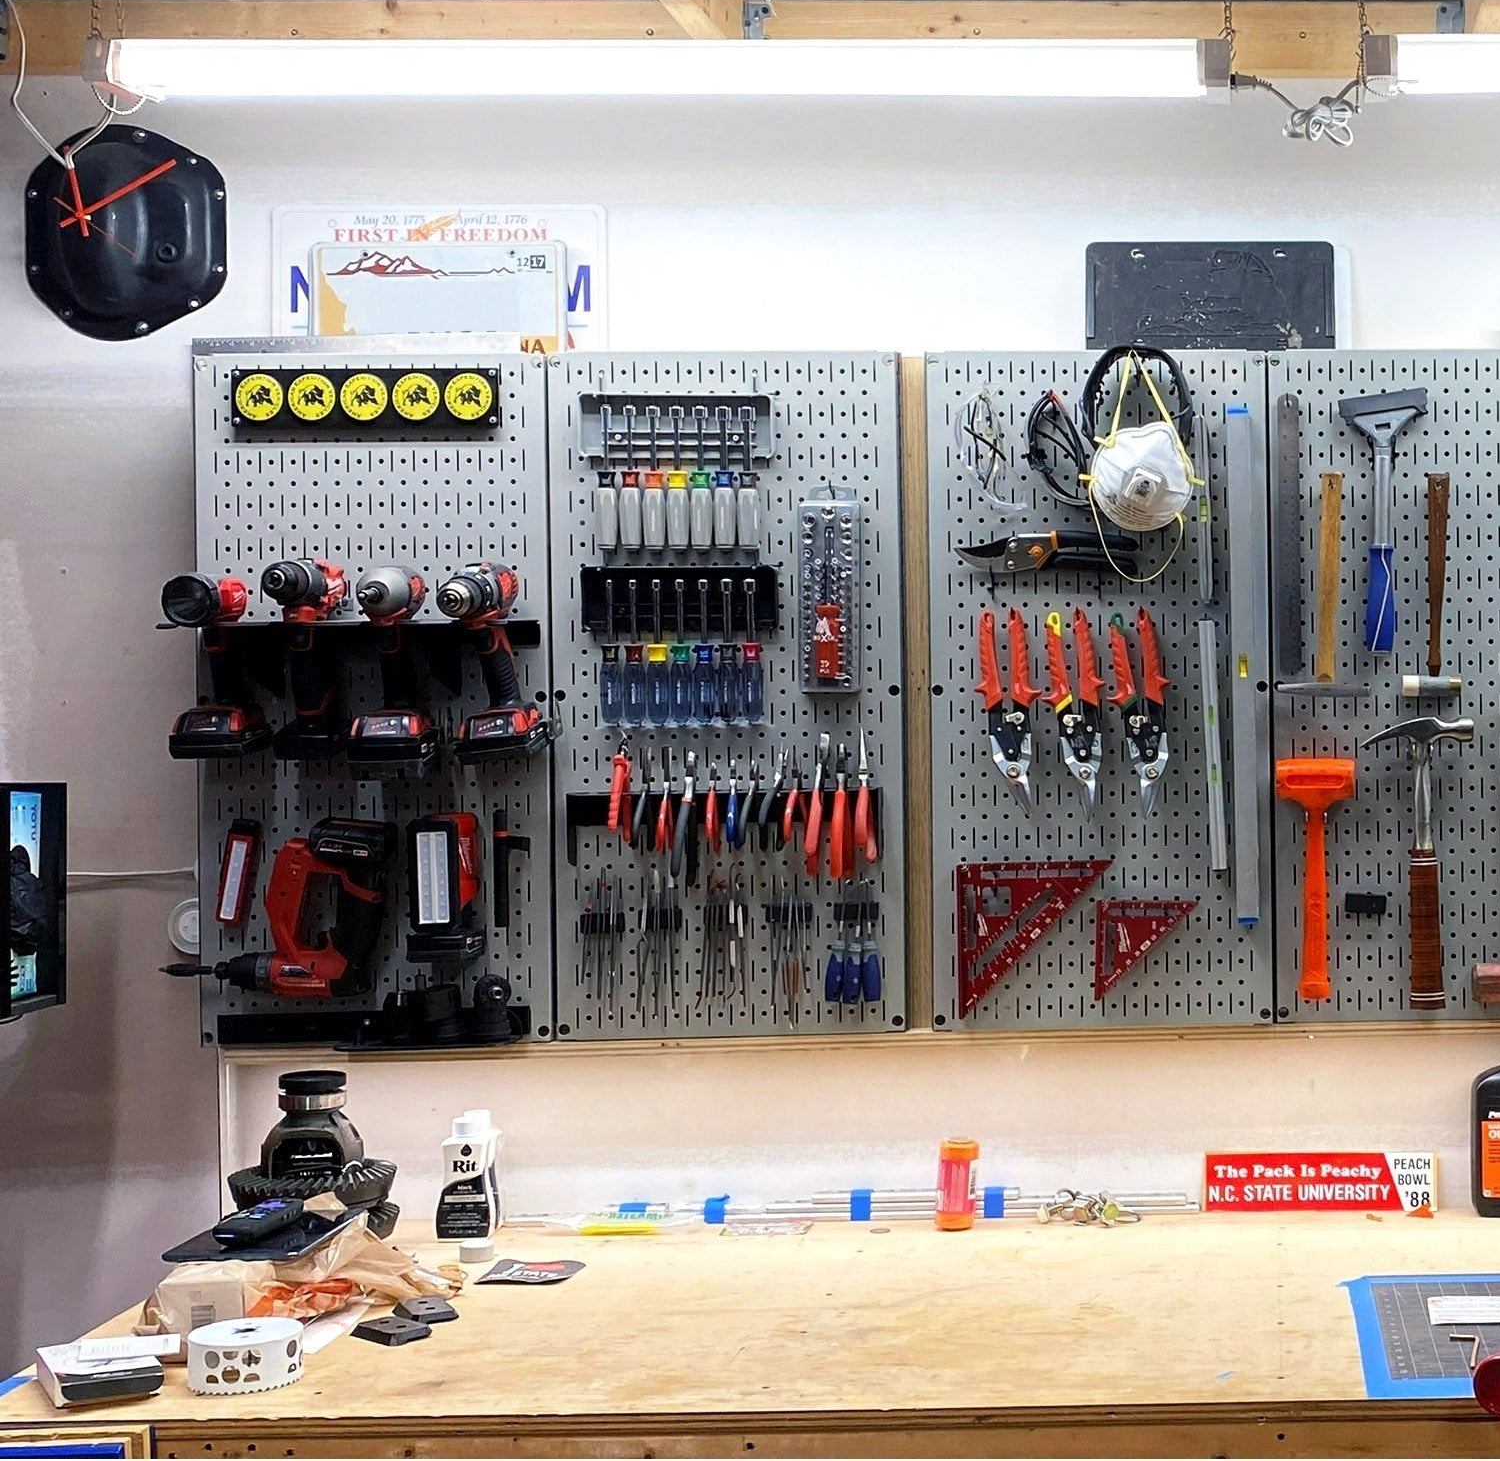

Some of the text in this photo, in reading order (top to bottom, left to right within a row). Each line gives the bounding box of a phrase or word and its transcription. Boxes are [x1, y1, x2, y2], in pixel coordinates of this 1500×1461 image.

[354, 215, 378, 227] May
[403, 215, 426, 225] 1775
[505, 215, 527, 224] 1776
[334, 228, 398, 242] FIRST
[440, 227, 547, 241] FREEDOM
[517, 255, 545, 269] 12 17
[452, 1159, 478, 1173] Rit
[1393, 1158, 1431, 1170] PEACH
[1214, 1164, 1382, 1180] The Pack Is Peachy
[1397, 1173, 1431, 1186] BOWL
[1208, 1184, 1391, 1202] N.C. STATE UNIVERSITY
